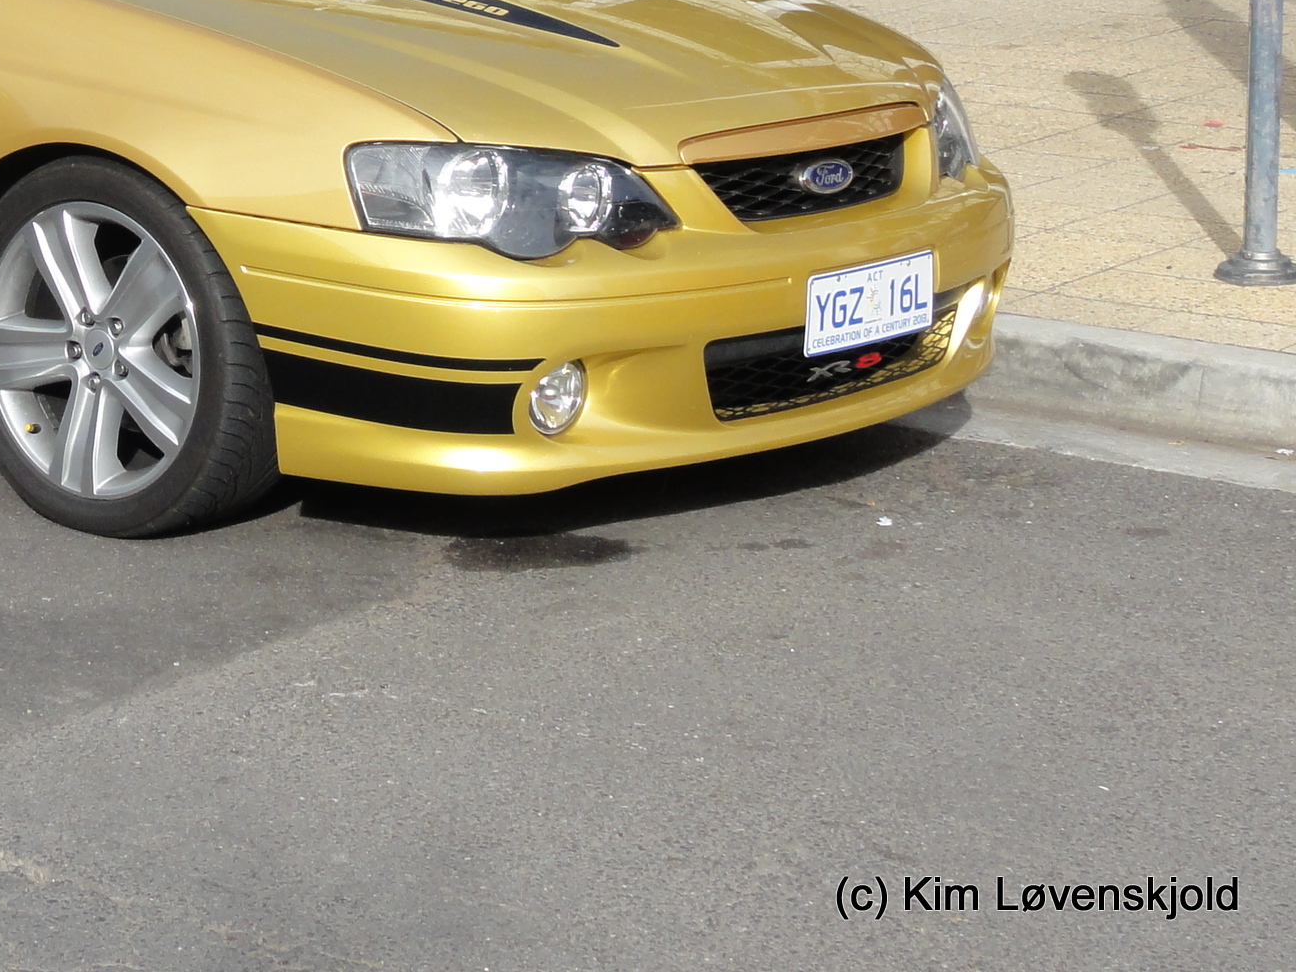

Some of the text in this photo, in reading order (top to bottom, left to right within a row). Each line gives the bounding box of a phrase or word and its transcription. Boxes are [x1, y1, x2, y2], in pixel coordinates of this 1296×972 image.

[815, 164, 844, 186] Ford
[866, 270, 884, 283] ACT
[815, 273, 928, 332] YGZ 16L
[812, 330, 862, 350] CELEBRATION
[863, 327, 874, 339] OF
[874, 325, 881, 335] A
[881, 318, 912, 334] CENTURY
